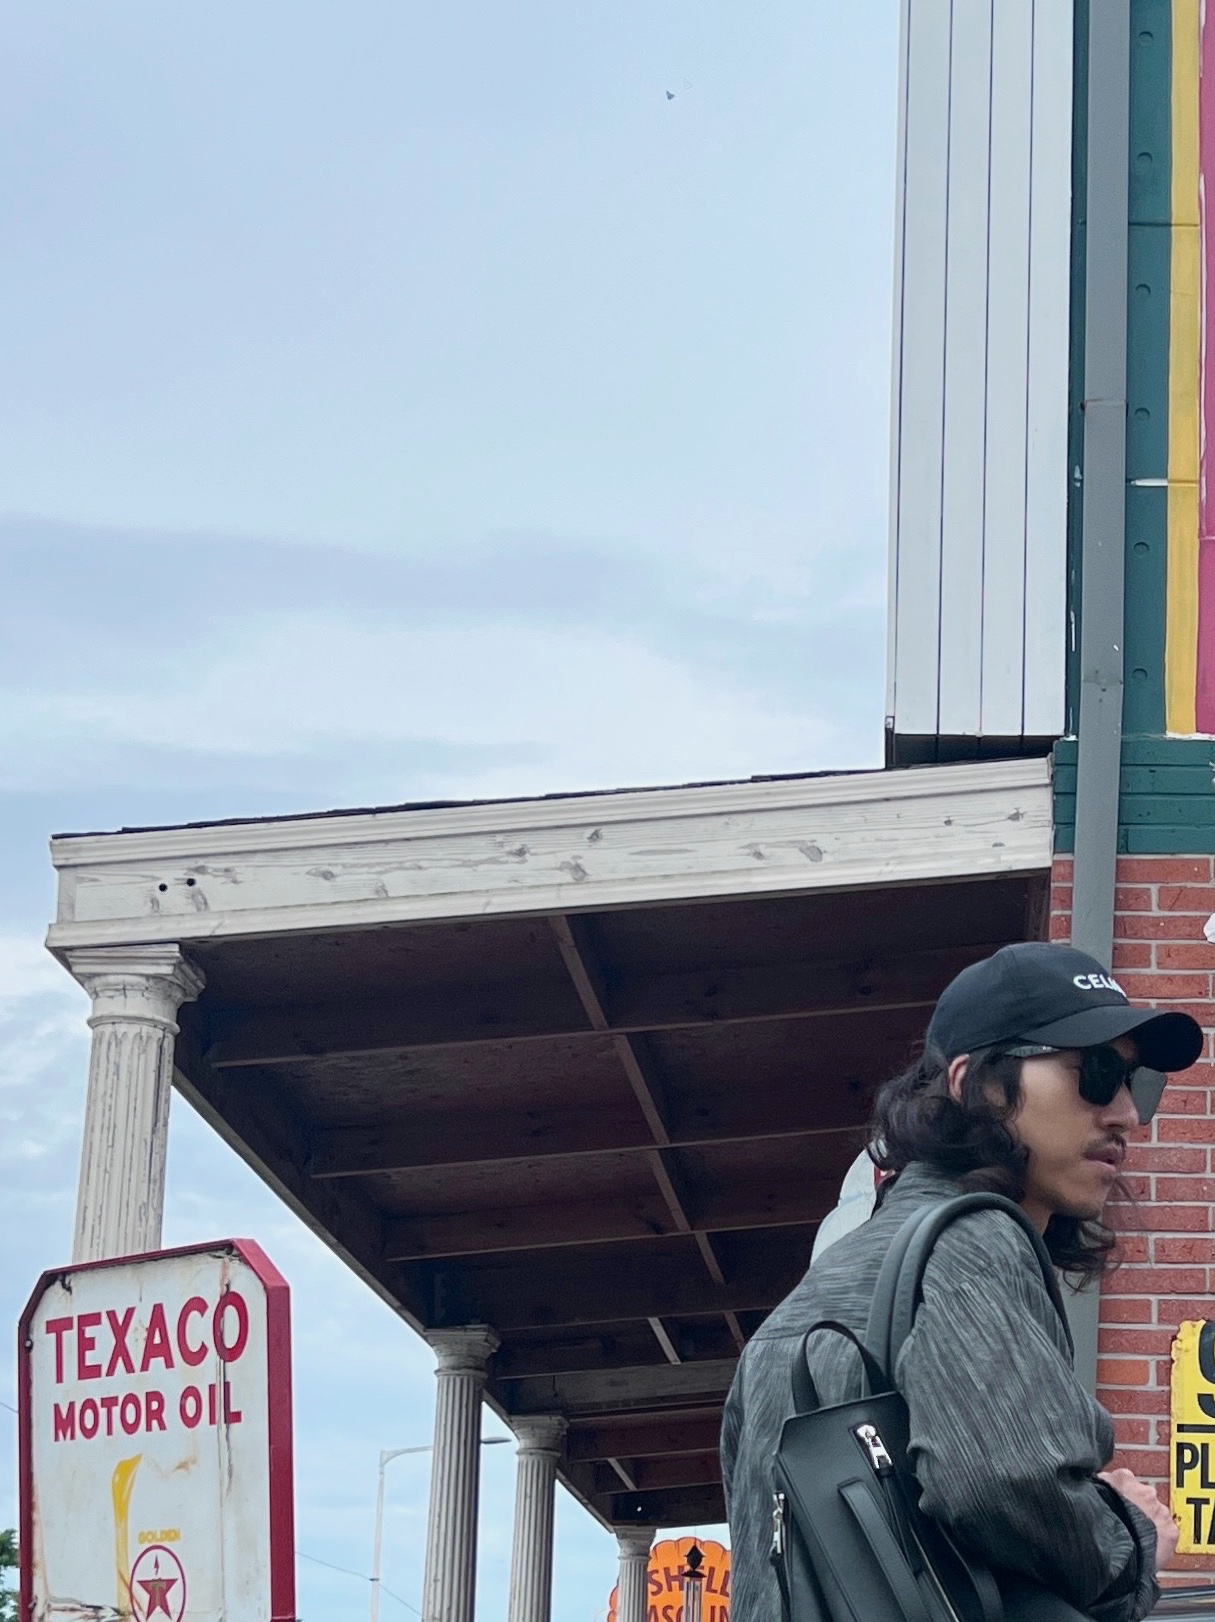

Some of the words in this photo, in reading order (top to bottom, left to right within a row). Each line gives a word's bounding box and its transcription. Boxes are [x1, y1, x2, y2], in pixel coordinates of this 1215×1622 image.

[45, 1290, 249, 1384] TEXACO
[53, 1390, 167, 1442] MOTOR
[179, 1380, 242, 1428] OIL
[647, 1565, 730, 1598] SHLL
